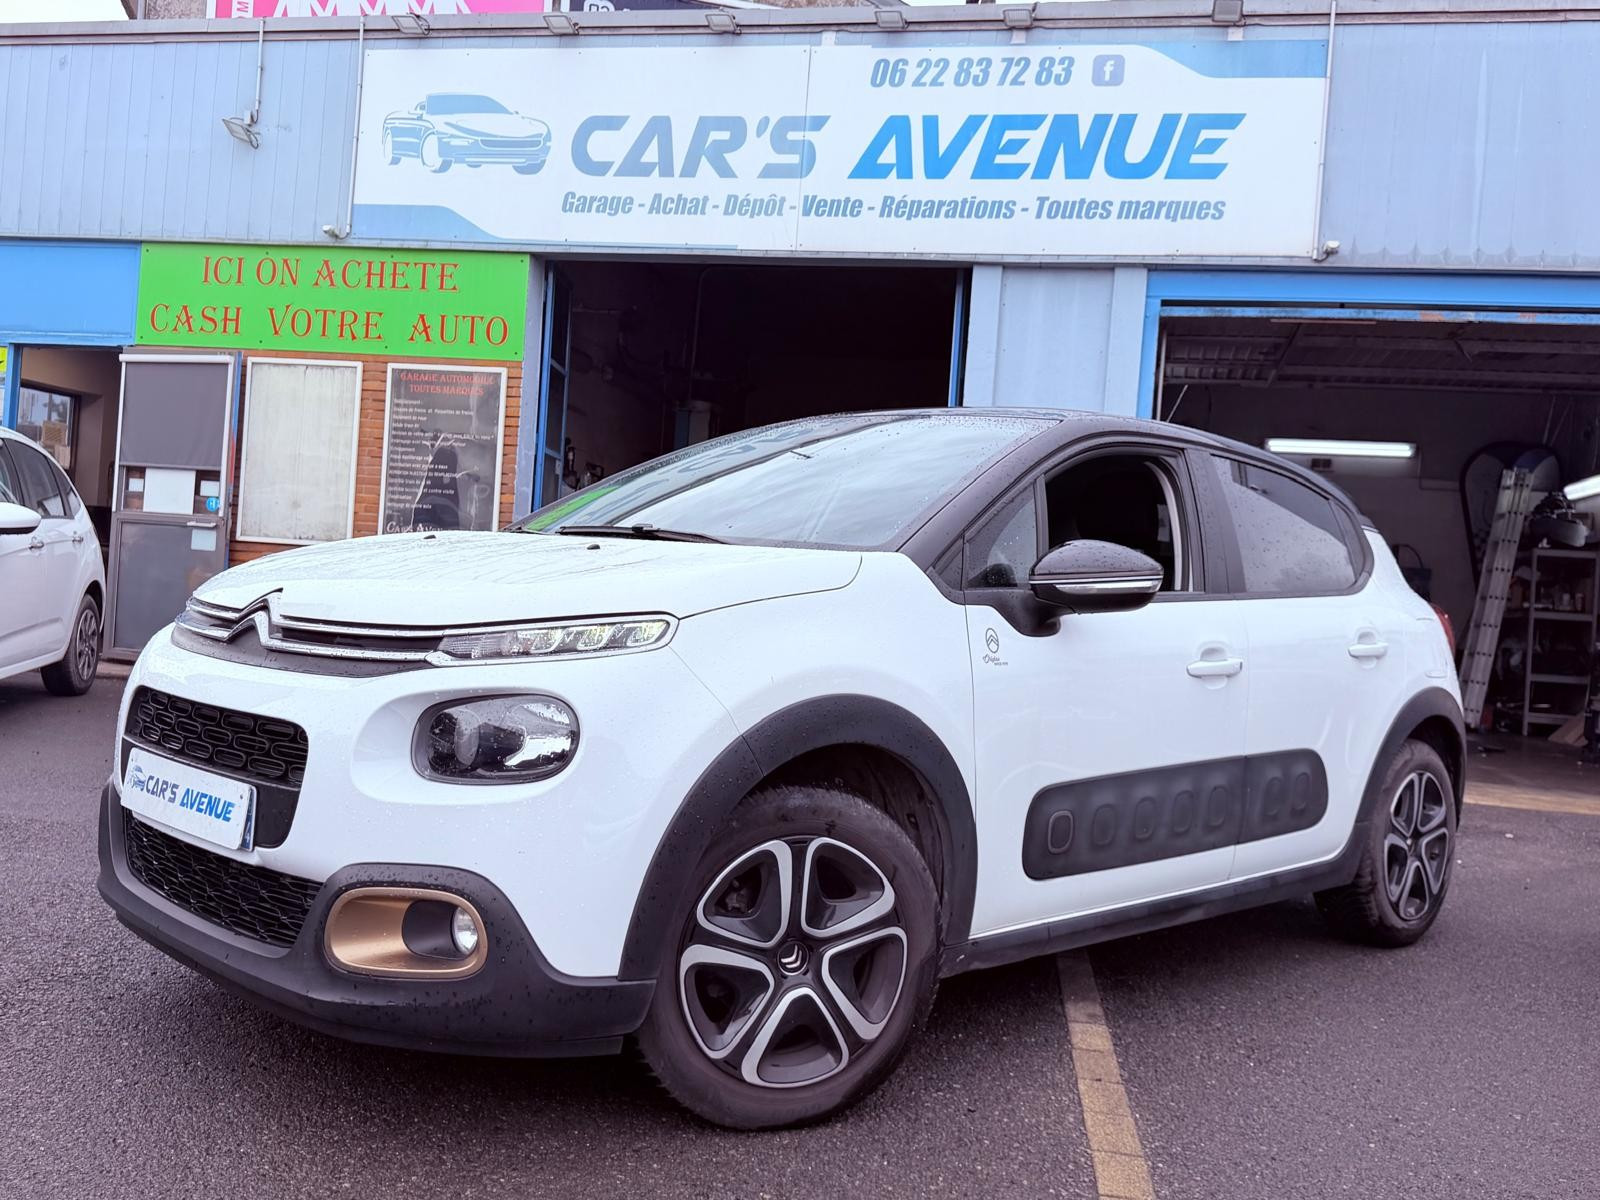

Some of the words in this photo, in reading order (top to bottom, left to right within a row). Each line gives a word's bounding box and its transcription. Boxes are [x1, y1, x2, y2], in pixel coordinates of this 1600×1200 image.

[870, 58, 909, 88] 06
[912, 58, 951, 88] 22
[953, 57, 993, 87] 83
[996, 56, 1031, 87] 72
[1035, 56, 1075, 87] 83
[571, 114, 832, 179] CAR'S
[846, 113, 1247, 180] AVENUE
[562, 192, 634, 216] Garage
[648, 193, 709, 216] Achat
[723, 194, 786, 219] Dépôt
[802, 195, 863, 218] Vente
[879, 195, 1017, 221] Réparations
[1035, 196, 1113, 220] Toutes
[1116, 200, 1226, 223] marques
[202, 256, 245, 285] ICI
[256, 257, 299, 287] ON
[313, 259, 460, 292] ACHETE
[149, 303, 242, 335] CASH
[267, 303, 384, 341] VOTRE
[408, 313, 509, 346] AUTO
[400, 371, 437, 383] GARAGE
[409, 384, 441, 394] TOUTES
[145, 775, 180, 804] CAR'S
[179, 787, 236, 822] AVENUE
